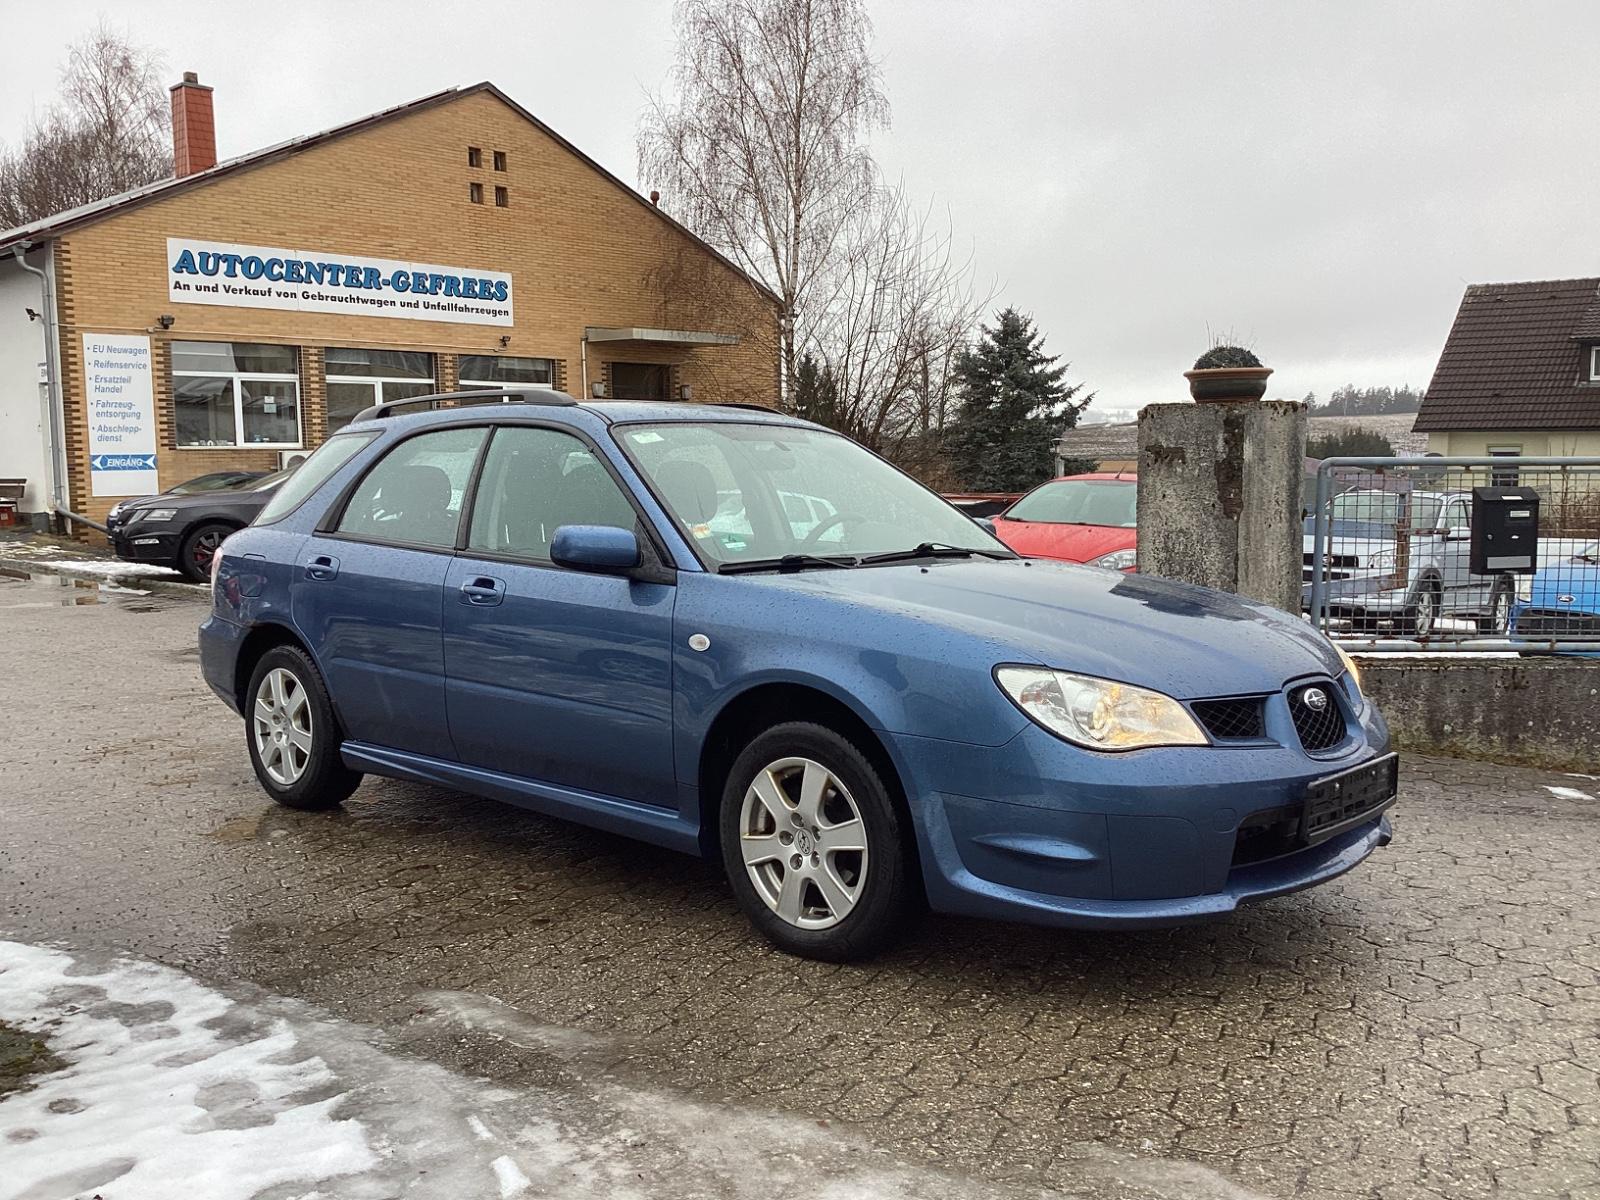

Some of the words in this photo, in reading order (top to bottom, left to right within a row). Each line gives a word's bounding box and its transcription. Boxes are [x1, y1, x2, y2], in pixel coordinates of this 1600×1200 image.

[172, 249, 508, 301] AUTOCENTER-GEFREES
[173, 281, 191, 291] An
[195, 283, 219, 293] und
[223, 284, 272, 297] Verkauf
[275, 291, 297, 299] von
[301, 291, 396, 308] Gebrauchtwagen
[400, 299, 420, 309] und
[422, 301, 509, 317] Unfallfahrzeugen
[92, 344, 105, 353] EU
[106, 345, 148, 356] Neuwagen
[93, 360, 148, 369] Reifenservice
[94, 374, 132, 384] Ersatzteil
[94, 385, 122, 393] Handel
[95, 400, 136, 410] Fahrzeug-
[95, 410, 141, 420] entsorgung
[97, 424, 142, 435] Abschlepp-
[97, 434, 122, 442] dienst
[107, 458, 143, 467] EINGANG
